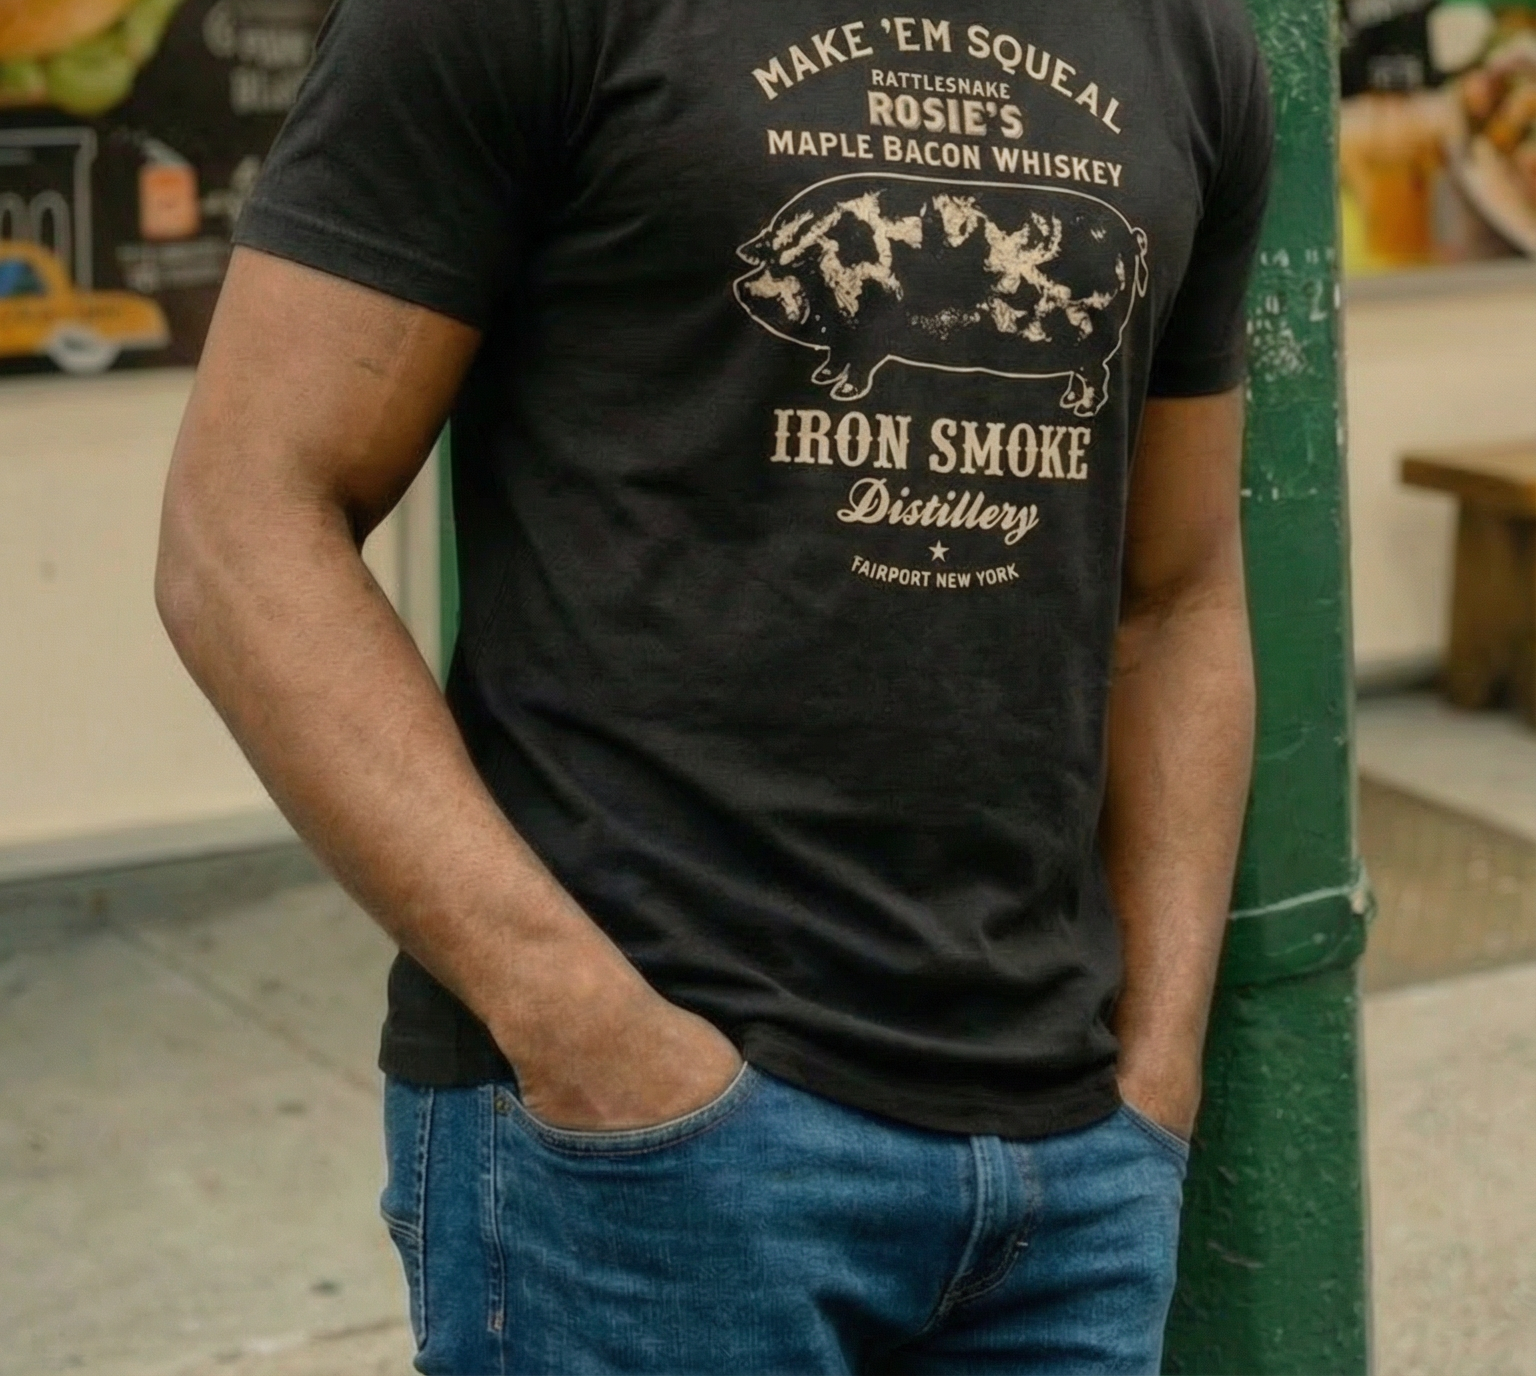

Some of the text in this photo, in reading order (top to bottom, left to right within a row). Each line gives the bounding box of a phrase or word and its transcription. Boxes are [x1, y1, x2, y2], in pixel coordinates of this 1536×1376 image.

[751, 20, 874, 101] MAKE
[967, 24, 1122, 135] SQUEAL
[871, 68, 1011, 100] RATTLESNAKE
[867, 90, 1024, 140] ROSIE'S
[766, 128, 1123, 188] MAPLE BACON WHISKEY
[770, 408, 1091, 480] IRON SMOKE
[836, 477, 1040, 546] Distillery
[851, 555, 1020, 589] FAIRPORT NEW YORK
